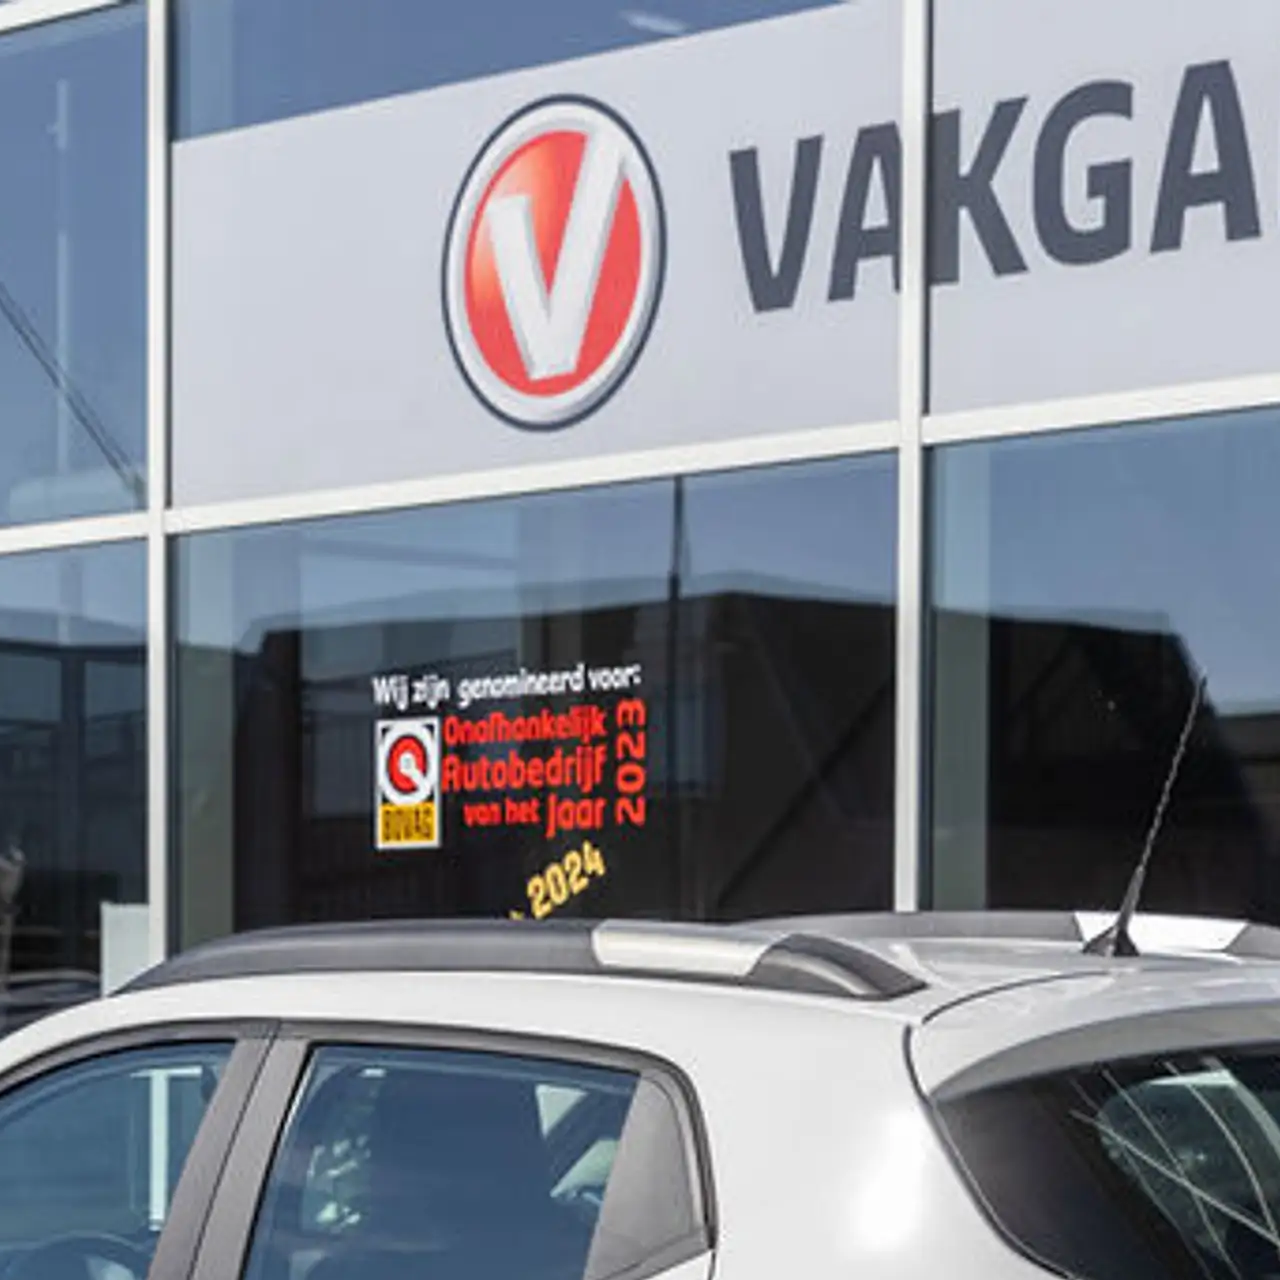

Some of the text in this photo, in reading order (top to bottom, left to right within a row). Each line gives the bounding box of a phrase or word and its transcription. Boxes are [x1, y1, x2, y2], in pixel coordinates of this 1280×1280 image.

[371, 663, 642, 711] Wij zijn genomineerd voor:
[443, 704, 608, 746] Onafhankelijk
[440, 744, 608, 793] Autobedrijf
[616, 697, 647, 827] 2023
[463, 802, 502, 827] van
[505, 797, 541, 825] het
[526, 839, 606, 920] 2024
